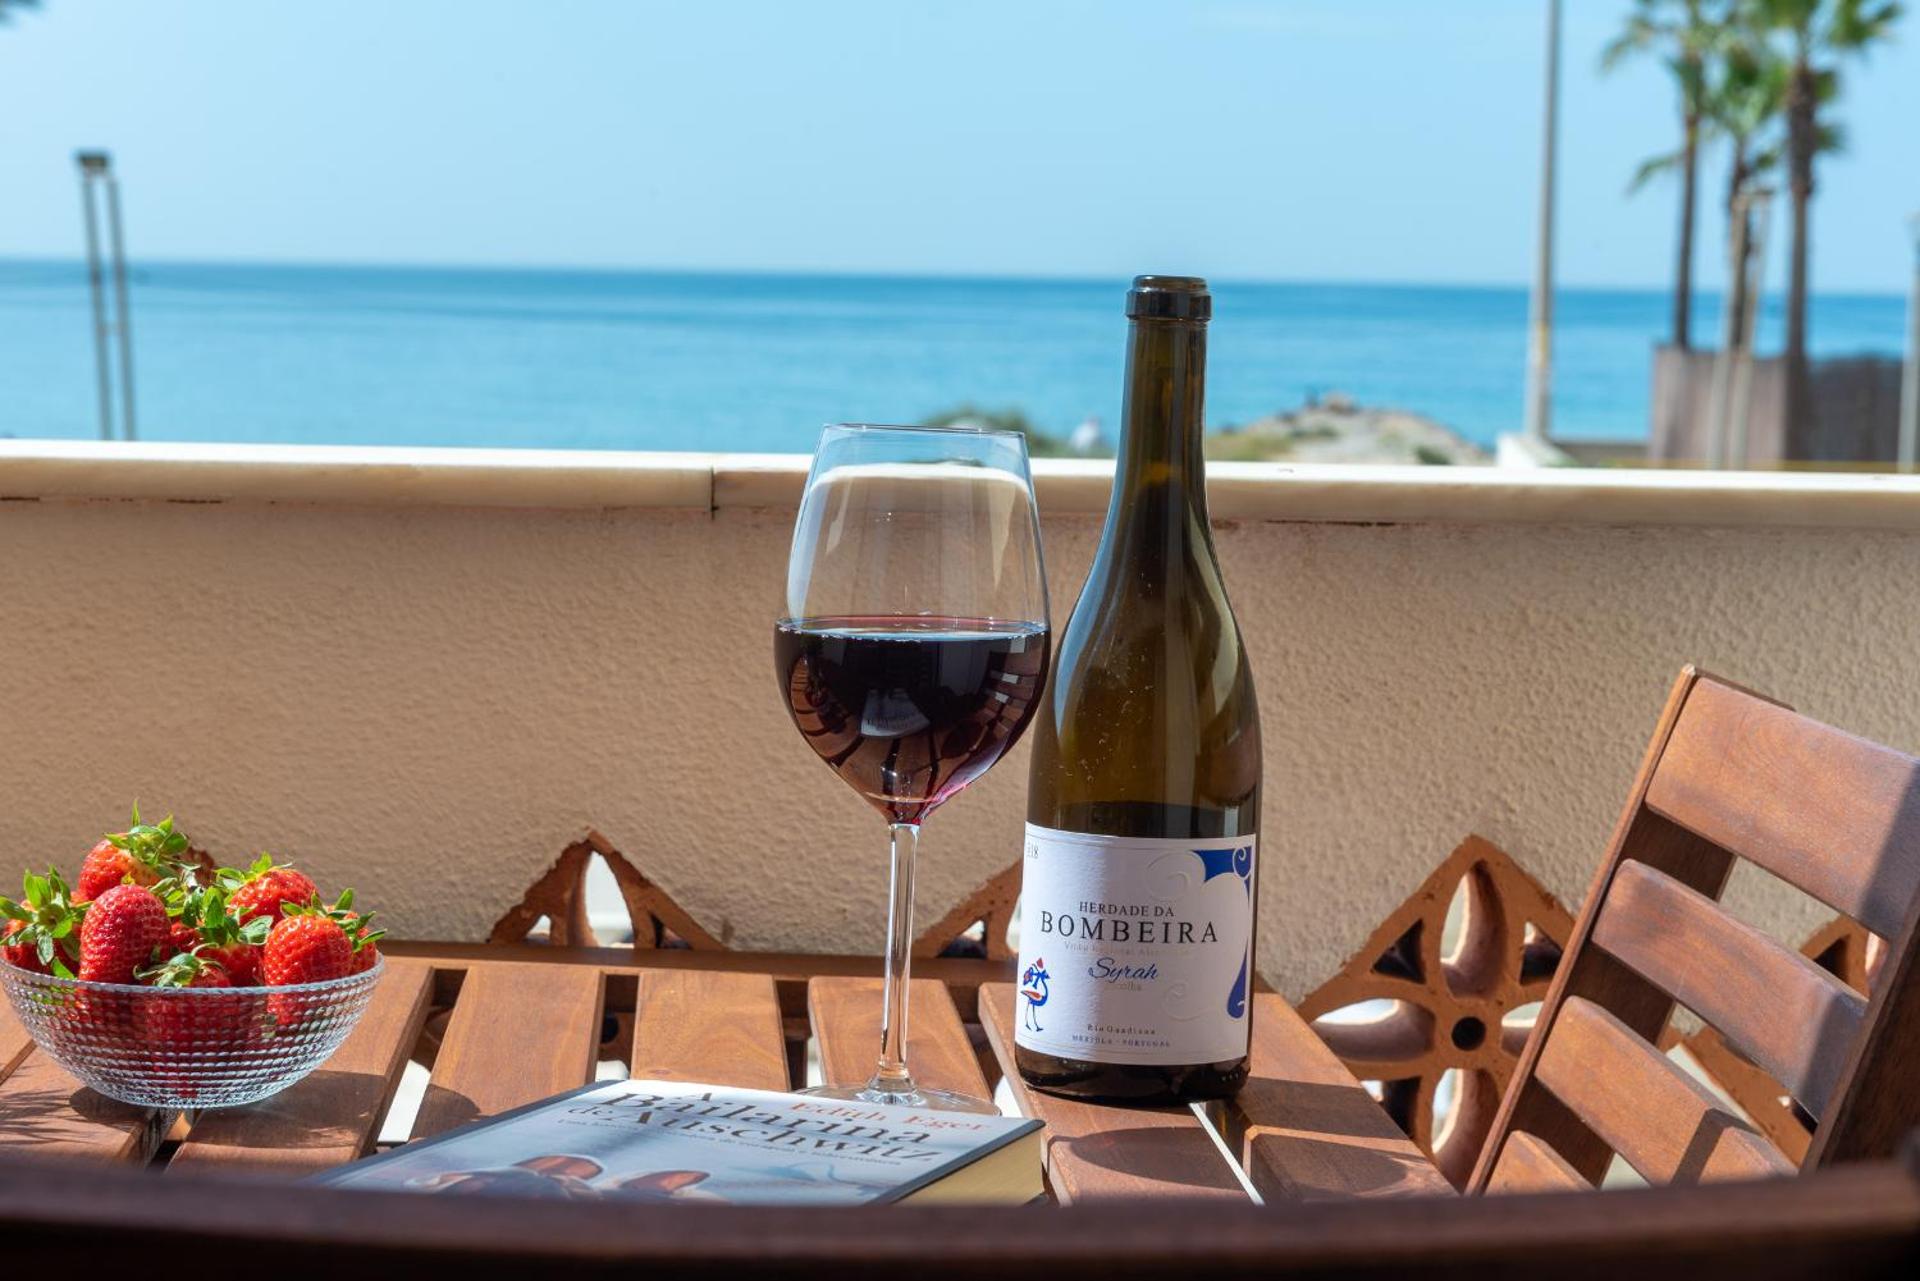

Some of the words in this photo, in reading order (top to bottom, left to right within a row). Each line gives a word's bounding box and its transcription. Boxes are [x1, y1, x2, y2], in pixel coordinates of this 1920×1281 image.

[1079, 901, 1149, 917] HERDADE
[1153, 906, 1175, 917] DA
[1041, 911, 1218, 943] BOMBEIRA
[1088, 957, 1159, 983] Syrah
[599, 1092, 931, 1144] Bailarina
[791, 1102, 887, 1122] Edith
[902, 1115, 994, 1132] Eger
[567, 1106, 614, 1116] de
[604, 1110, 943, 1162] Auschwitz
